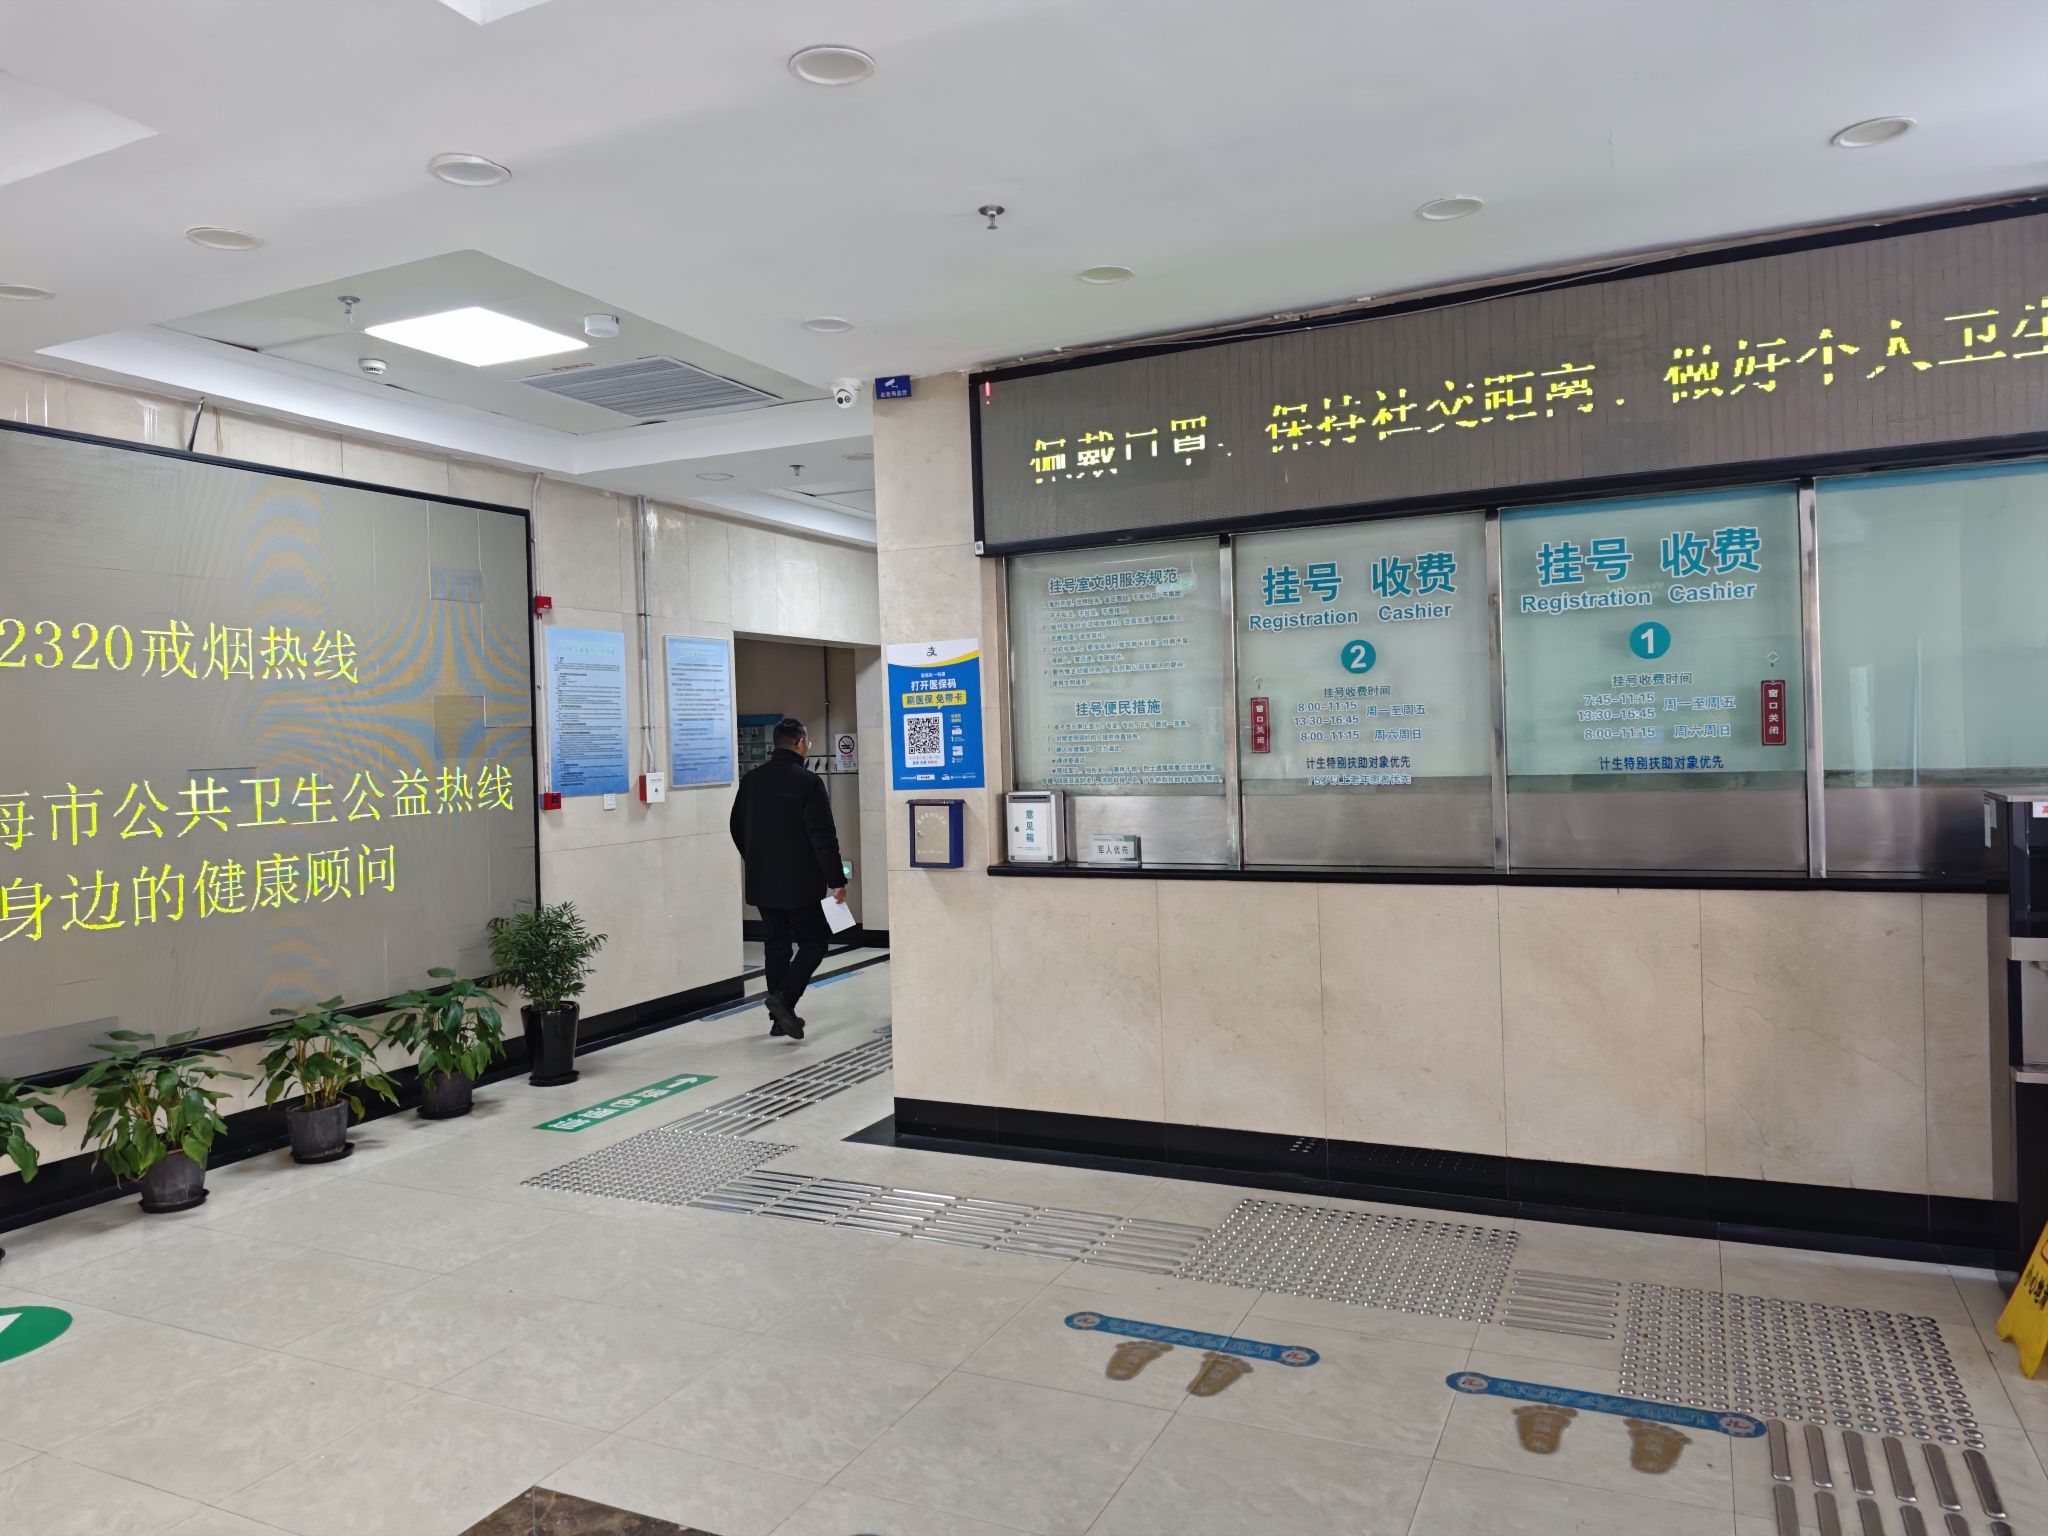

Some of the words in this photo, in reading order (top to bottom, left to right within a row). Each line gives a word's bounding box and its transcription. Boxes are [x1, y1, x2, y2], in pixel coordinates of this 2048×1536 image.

[1536, 537, 1633, 586] 挂号
[1660, 526, 1761, 577] 收费
[1049, 568, 1178, 595] 挂号室文明服务规范
[1262, 561, 1342, 606] 挂号
[1371, 552, 1457, 598] 收费
[1522, 588, 1651, 614] Registration
[1669, 582, 1756, 603] Cashier
[1249, 609, 1358, 632] Registration
[1378, 603, 1452, 622] Cashier
[1640, 628, 1655, 654] 1
[1350, 645, 1367, 669] 2
[911, 678, 957, 691] 打开医保码
[1612, 673, 1692, 687] 挂号收费时间
[1324, 685, 1391, 698] 挂号收费时间
[1076, 699, 1161, 716] 挂号便民措施
[1366, 704, 1426, 716] 周一至周五
[1664, 696, 1736, 711] 周一至周五
[1375, 728, 1421, 740] 周六周日
[1674, 724, 1731, 738] 周六周日
[1306, 756, 1411, 770] 计生特别扶助对象优先
[1599, 755, 1724, 771] 计生特别扶助对象优先
[1025, 809, 1035, 843] 意见箱
